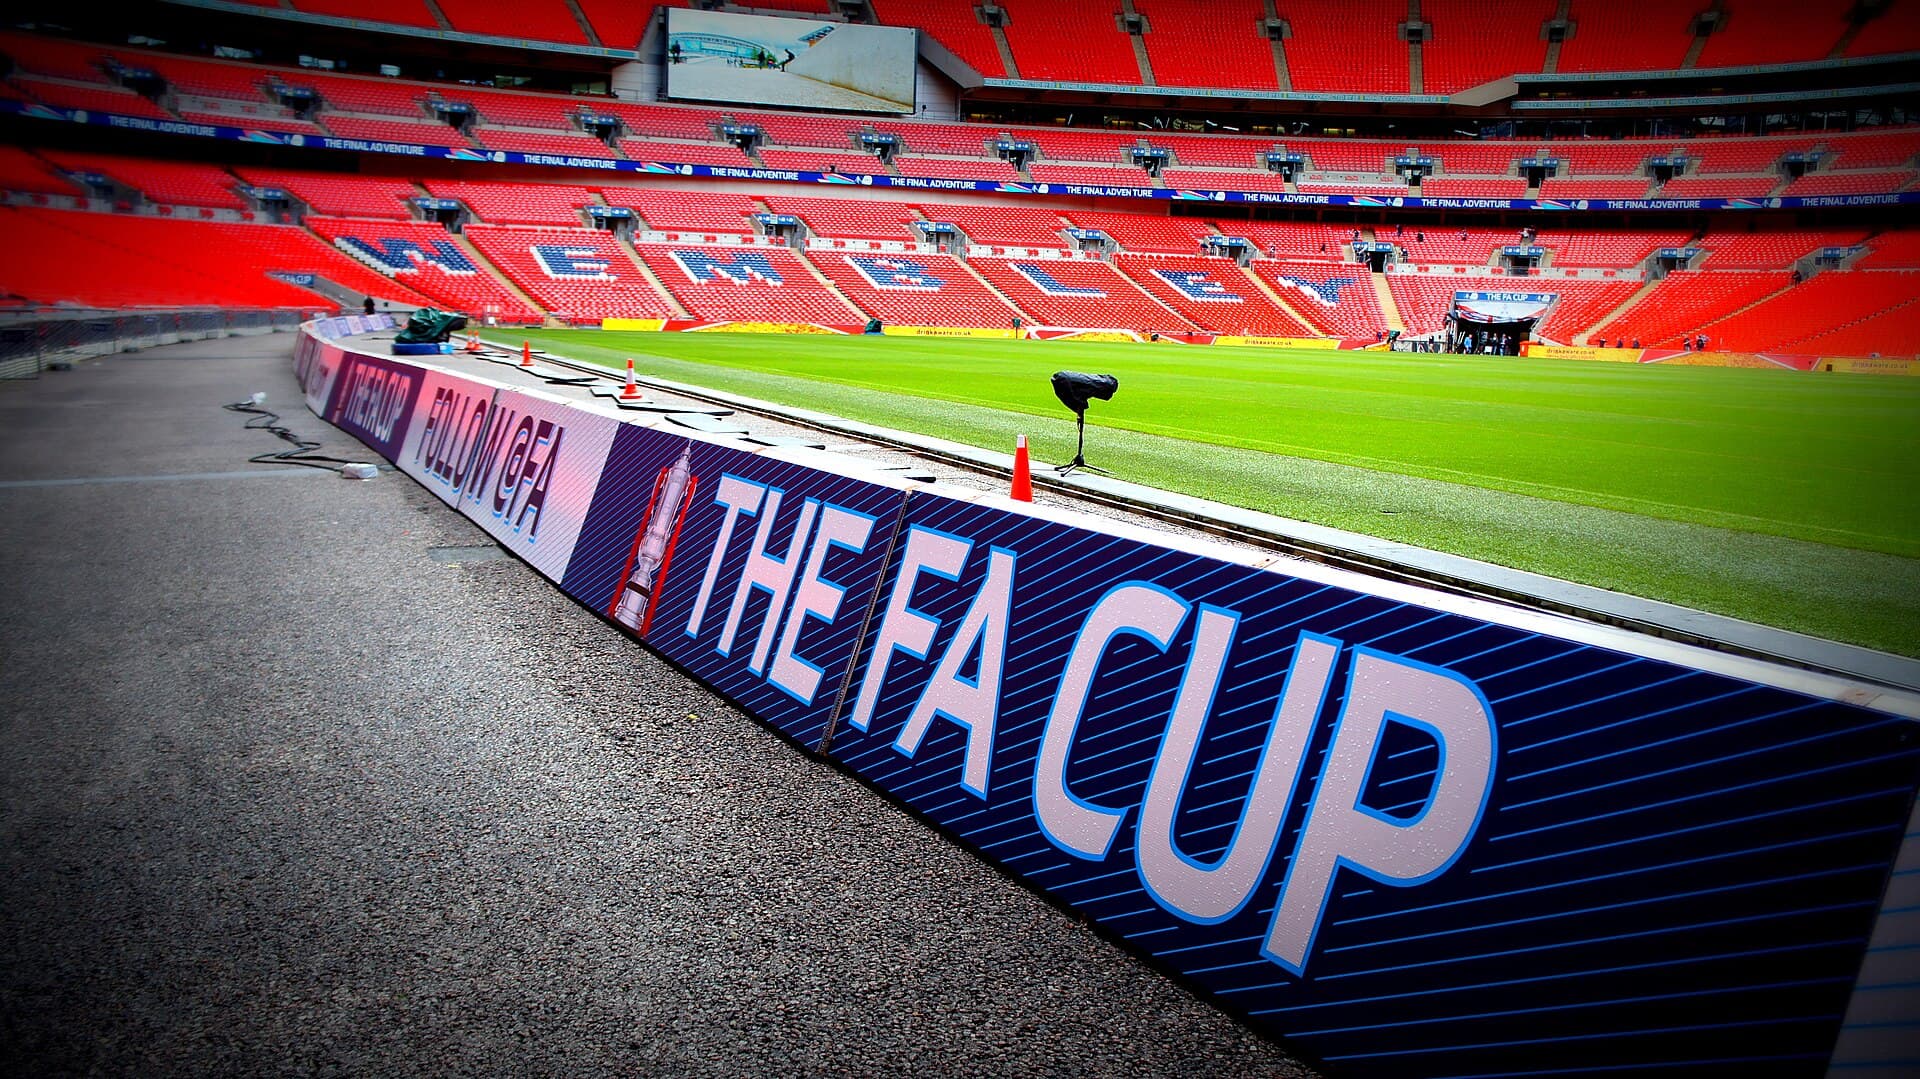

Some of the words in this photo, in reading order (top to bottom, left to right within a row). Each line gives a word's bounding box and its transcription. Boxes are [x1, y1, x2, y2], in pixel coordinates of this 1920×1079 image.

[108, 116, 128, 127] THE
[130, 118, 157, 131] FINAL
[158, 121, 216, 137] ADVENTURE
[324, 138, 342, 148] THE
[344, 140, 369, 150] FINAL
[370, 142, 424, 155] ADVENTURE
[523, 154, 541, 164] THE
[542, 156, 566, 166] FINAL
[566, 157, 616, 169] ADVENTURE
[710, 168, 726, 176] THE
[727, 168, 750, 178] FINAL
[751, 170, 799, 180] ADVENTURE
[890, 178, 906, 186] THE
[906, 178, 928, 188] FINAL
[930, 180, 976, 190] ADVENTURE
[1066, 186, 1082, 194] THE
[1082, 187, 1104, 196] FINAL
[1105, 188, 1152, 198] ADVENTURE
[1243, 193, 1258, 201] THE
[1260, 194, 1282, 202] FINAL
[1282, 195, 1329, 204] ADVENTURE
[1421, 199, 1438, 207] THE
[1438, 199, 1462, 207] FINAL
[1462, 200, 1511, 208] ADVENTURE
[1607, 201, 1624, 209] THE
[1625, 201, 1649, 209] FINAL
[1650, 201, 1700, 209] ADVENTURE
[1801, 198, 1819, 206] THE
[1820, 197, 1845, 206] FINAL
[1846, 194, 1900, 205] ADVENTURE
[1486, 293, 1501, 301] THE
[1502, 293, 1512, 301] FA
[1513, 293, 1529, 301] CUP
[344, 363, 377, 426] THE
[362, 368, 388, 434] FA
[374, 372, 411, 442] CUP
[414, 387, 515, 504] FOLLOW
[685, 472, 879, 707] THE
[849, 523, 1017, 800] FA
[1032, 580, 1498, 977] CUP
